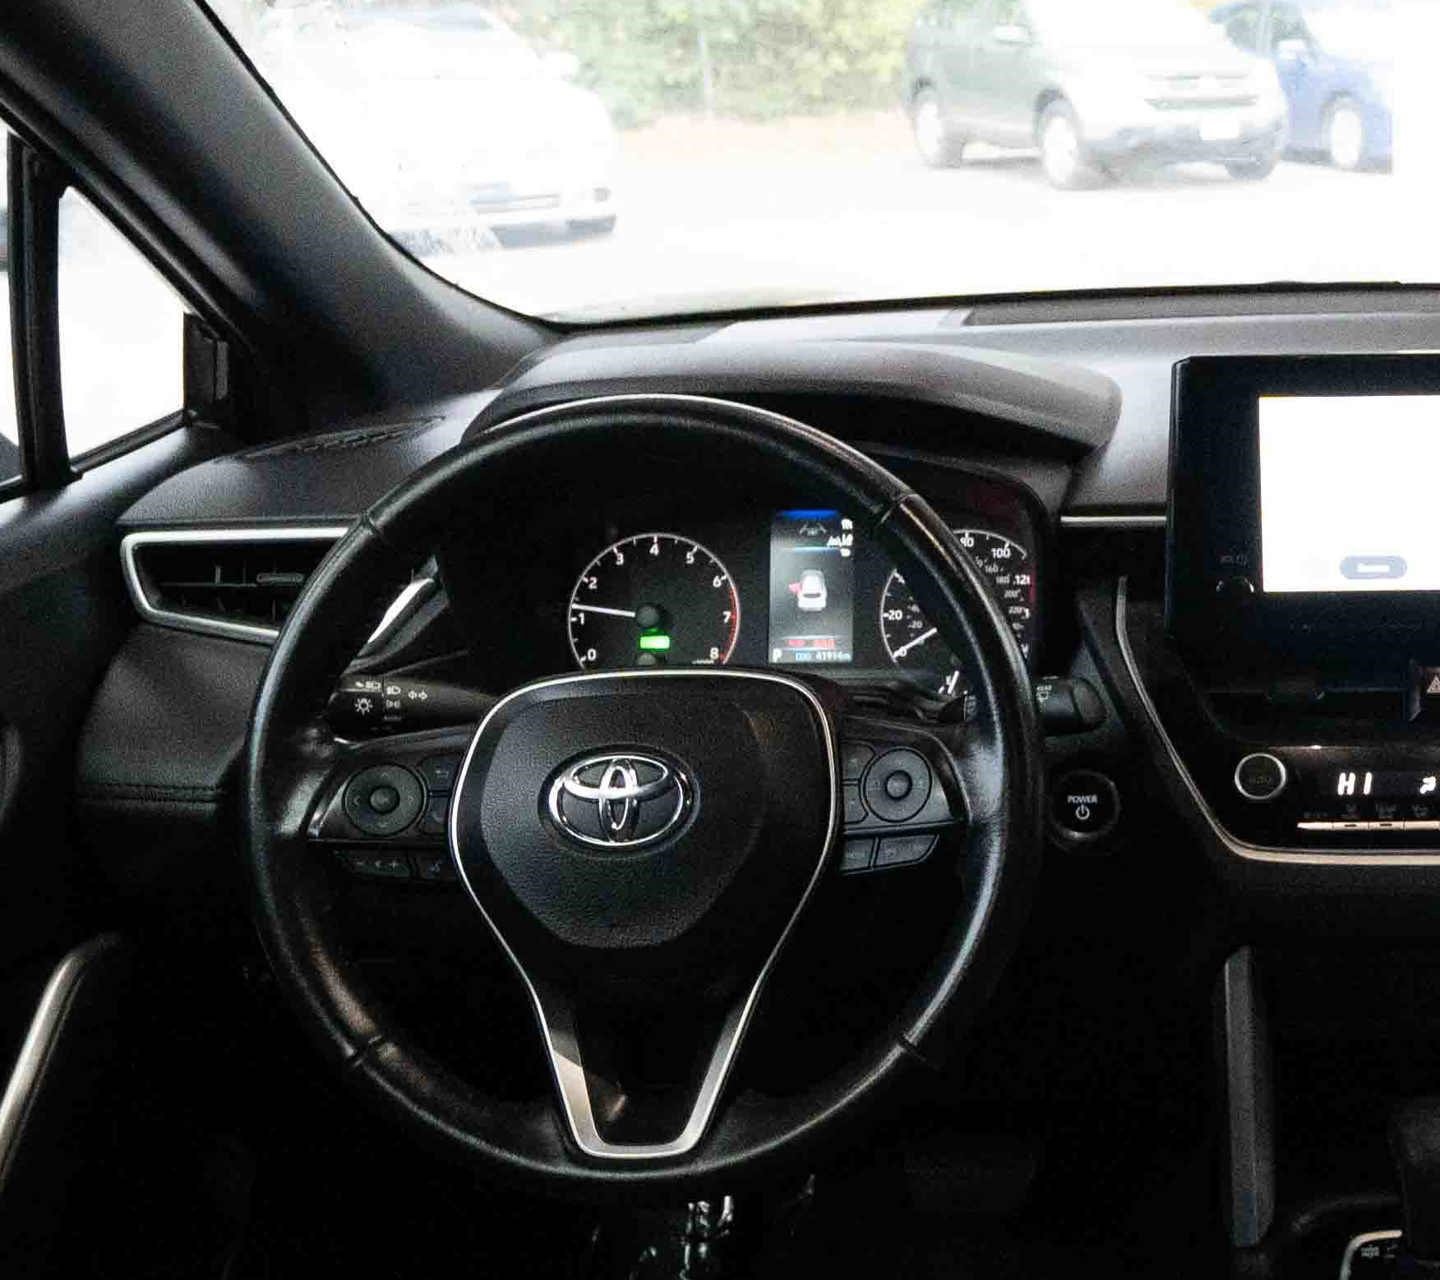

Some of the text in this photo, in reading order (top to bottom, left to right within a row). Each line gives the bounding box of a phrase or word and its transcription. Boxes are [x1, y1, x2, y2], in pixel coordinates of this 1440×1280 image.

[649, 544, 659, 556] 4
[991, 548, 1011, 559] 100
[615, 553, 624, 565] 3
[686, 552, 695, 564] 5
[589, 577, 598, 589] 2
[712, 575, 721, 588] 6
[579, 613, 585, 625] 1
[722, 611, 732, 624] 7
[888, 609, 903, 620] 20
[587, 649, 597, 661] 0
[709, 648, 719, 660] 8
[772, 648, 782, 662] P
[1337, 771, 1373, 796] HI
[1067, 794, 1098, 803] POWER
